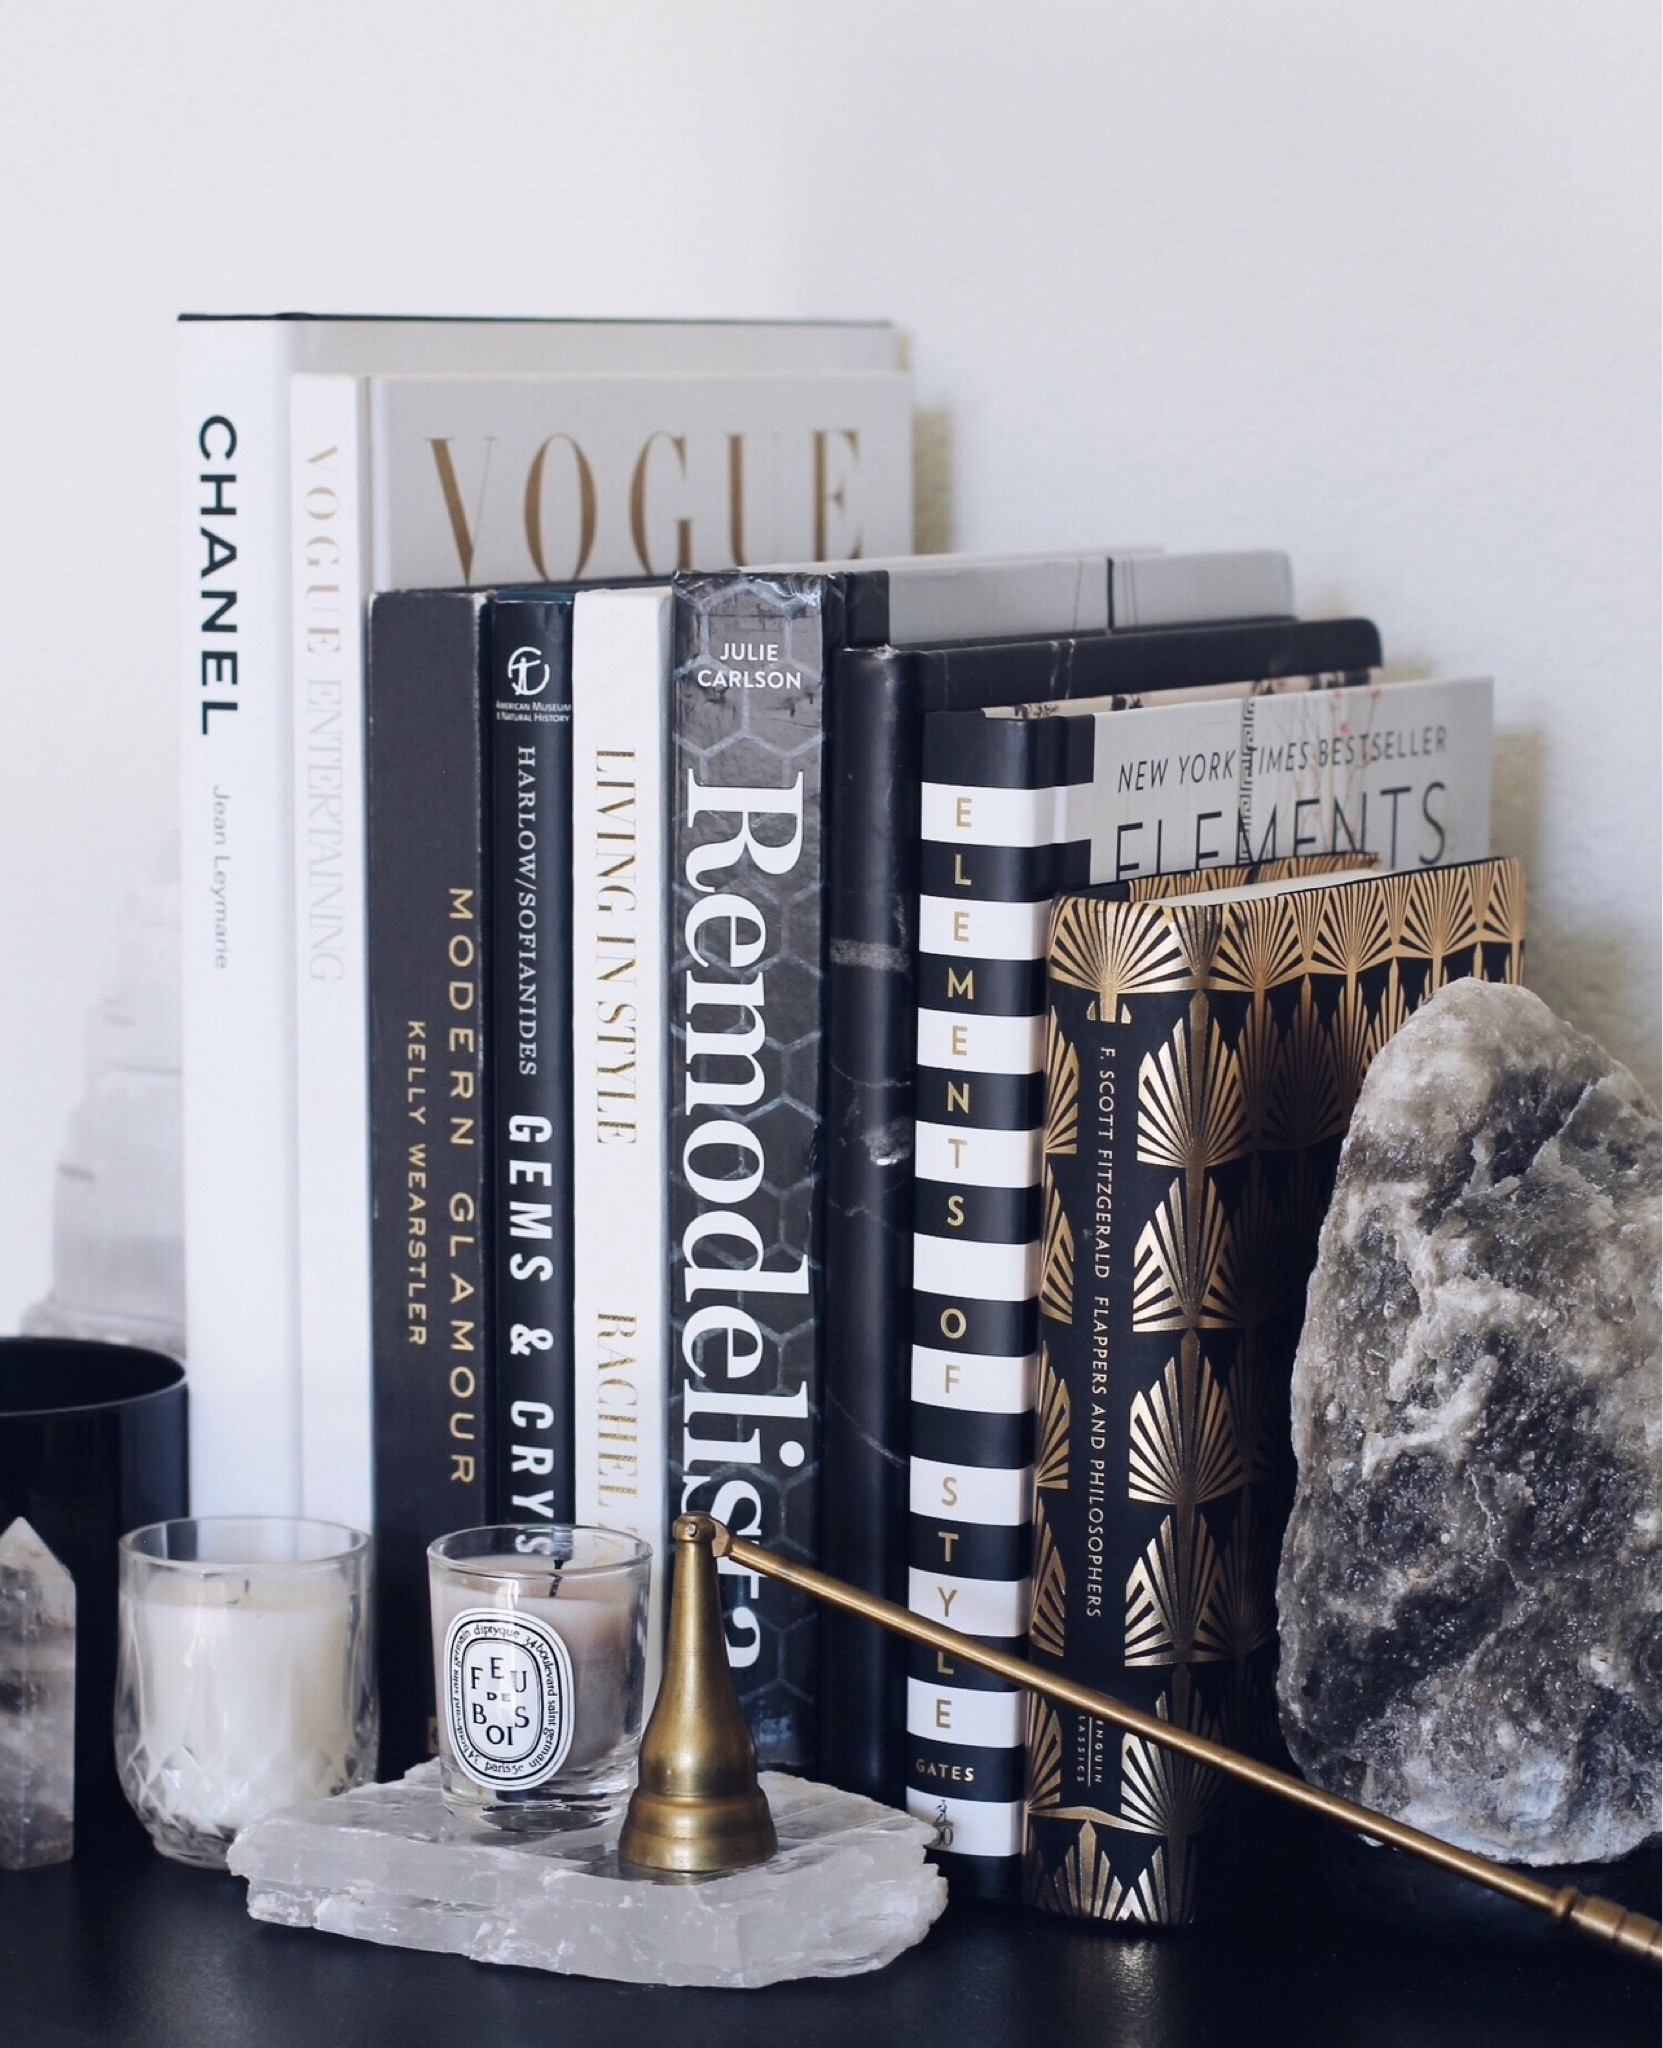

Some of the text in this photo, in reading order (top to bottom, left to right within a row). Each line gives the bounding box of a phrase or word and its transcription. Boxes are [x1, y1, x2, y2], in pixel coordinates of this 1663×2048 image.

[199, 415, 238, 736] CHANEL
[425, 430, 863, 585] VOGUE
[305, 445, 344, 983] VOGUE ENTERTAINING
[697, 670, 801, 689] CARLSON
[720, 643, 778, 661] JULIE
[1117, 725, 1447, 793] NEW YORK TIMES BESTSELLER
[210, 785, 231, 969] Jean Leymarie
[517, 746, 537, 1076] HARLOW/SOFIANIDES
[596, 750, 638, 1144] LIVING IN STYLE
[407, 1020, 427, 1346] KELLY WEARSTLER
[449, 888, 476, 1484] MODERN GLAMOUR
[508, 1115, 554, 1283] GEMS
[936, 796, 975, 1729] ELEMENTS OF STYLE
[510, 1323, 554, 1356] &
[597, 1310, 638, 1507] RACHEL
[1086, 1046, 1116, 1618] F. SCOTT FITZGERALD FLAPPERS AND PHILOSOPHERS
[470, 1657, 527, 1692] FEU
[474, 1624, 521, 1639] diptyque
[486, 1691, 512, 1702] DE
[472, 1703, 530, 1745] BOIS
[915, 1757, 975, 1782] GATES
